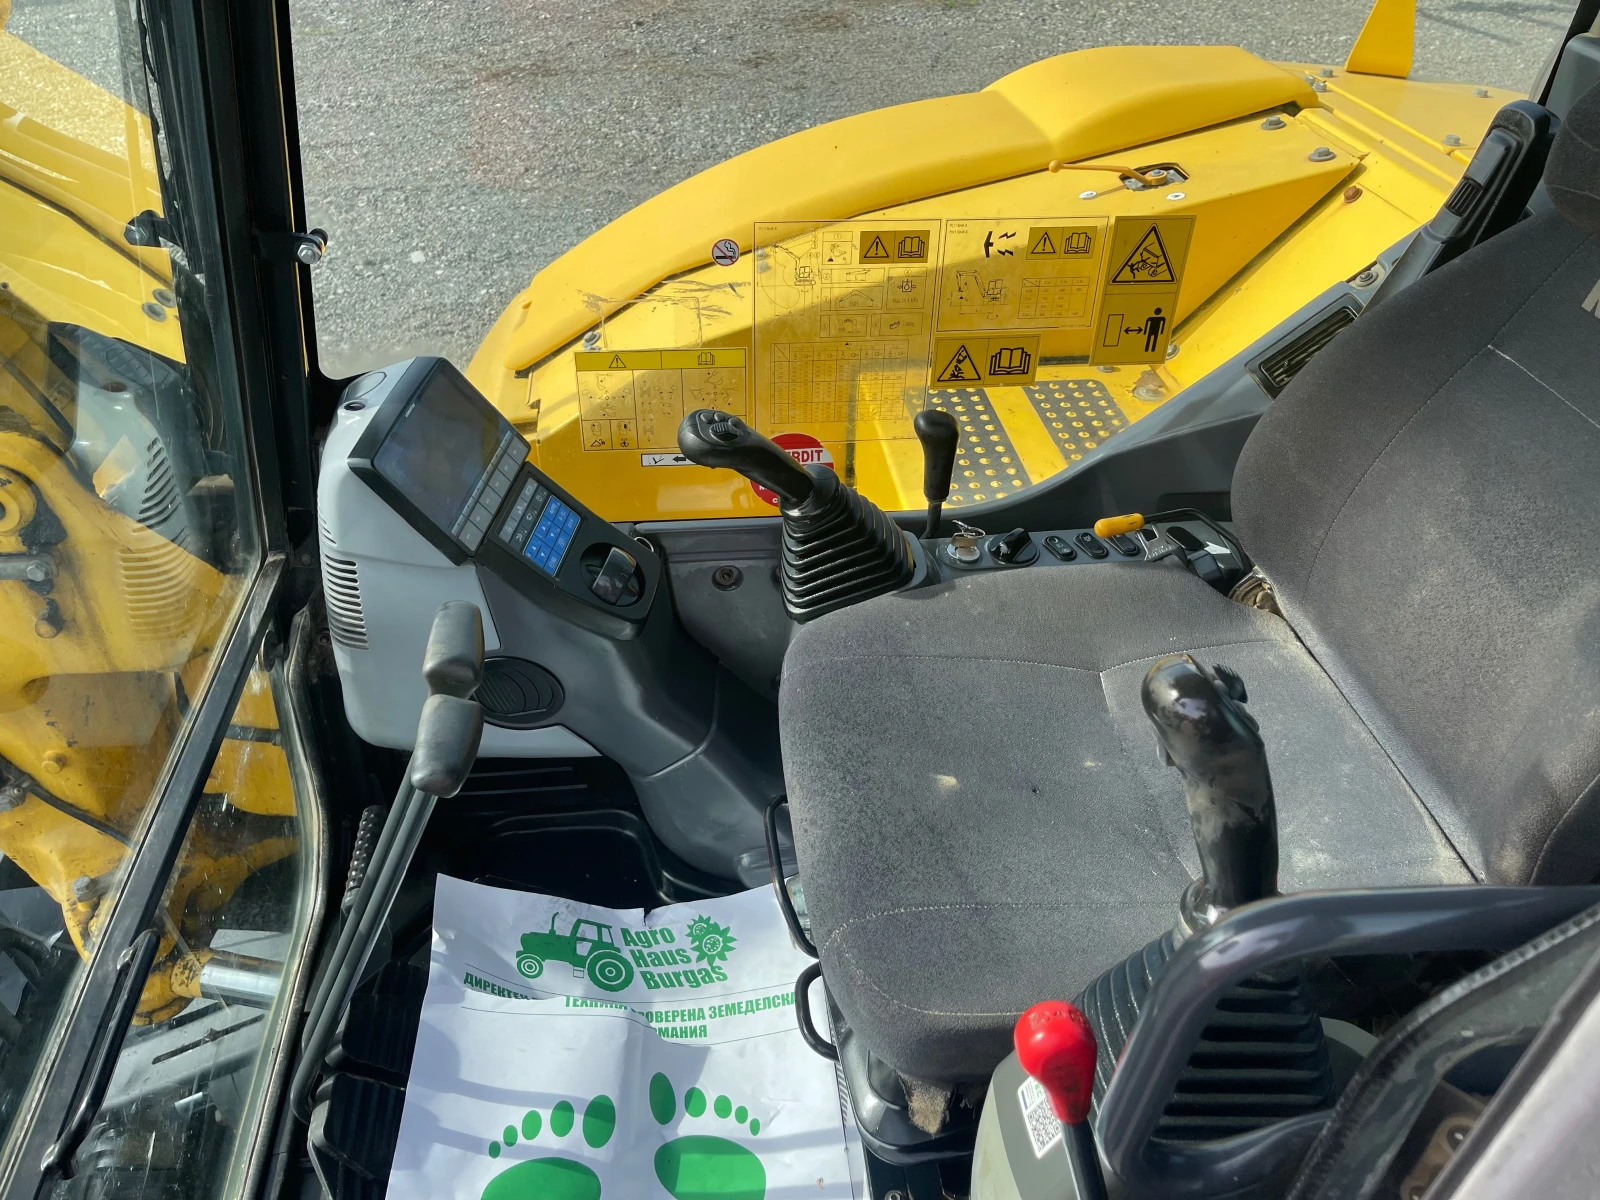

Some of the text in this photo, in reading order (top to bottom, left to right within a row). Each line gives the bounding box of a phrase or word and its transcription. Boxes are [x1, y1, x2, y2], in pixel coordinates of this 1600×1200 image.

[787, 450, 823, 463] RDIT
[620, 927, 676, 949] Agro
[629, 948, 693, 968] Haus
[639, 965, 729, 990] Burgas
[654, 1024, 708, 1039] МАНИЯ
